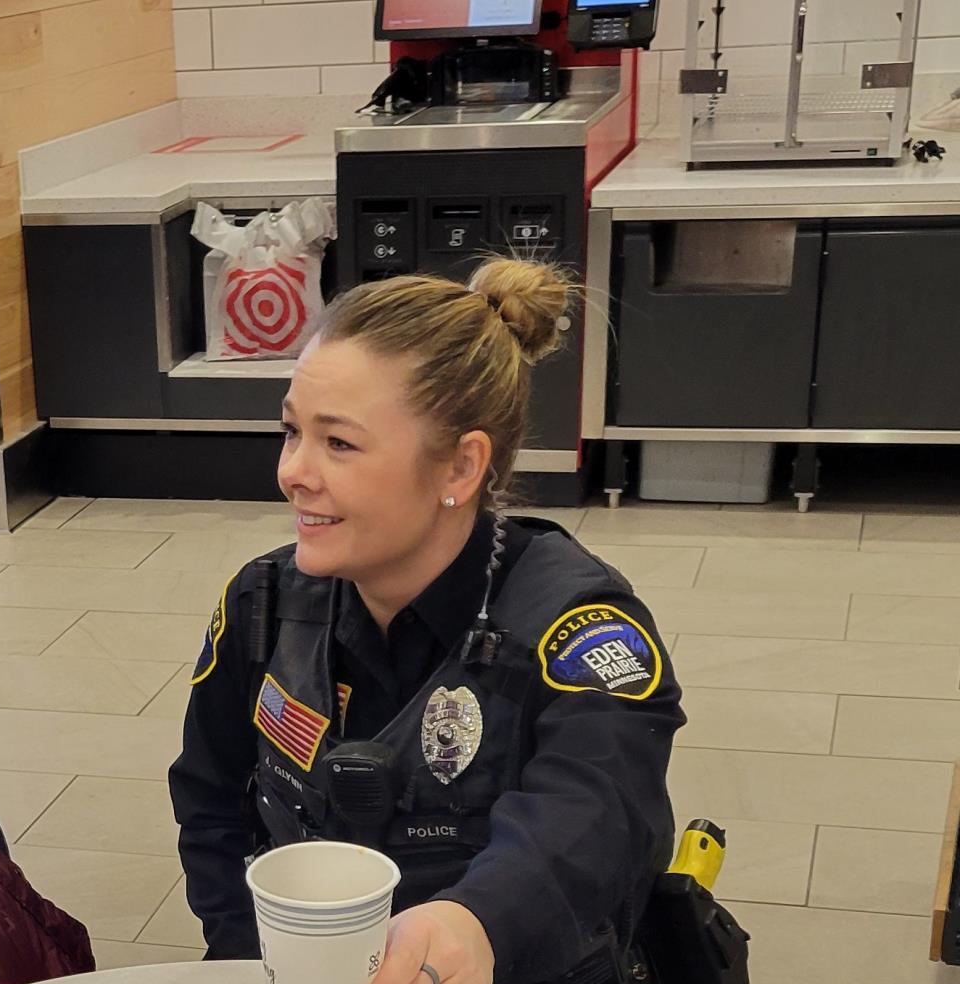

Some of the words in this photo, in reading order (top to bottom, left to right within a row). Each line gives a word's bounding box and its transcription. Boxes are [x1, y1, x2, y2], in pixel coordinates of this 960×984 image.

[548, 610, 614, 652] POLICE
[581, 639, 634, 670] EDEN
[596, 656, 646, 681] PRAIRIE
[407, 826, 457, 838] POLICE
